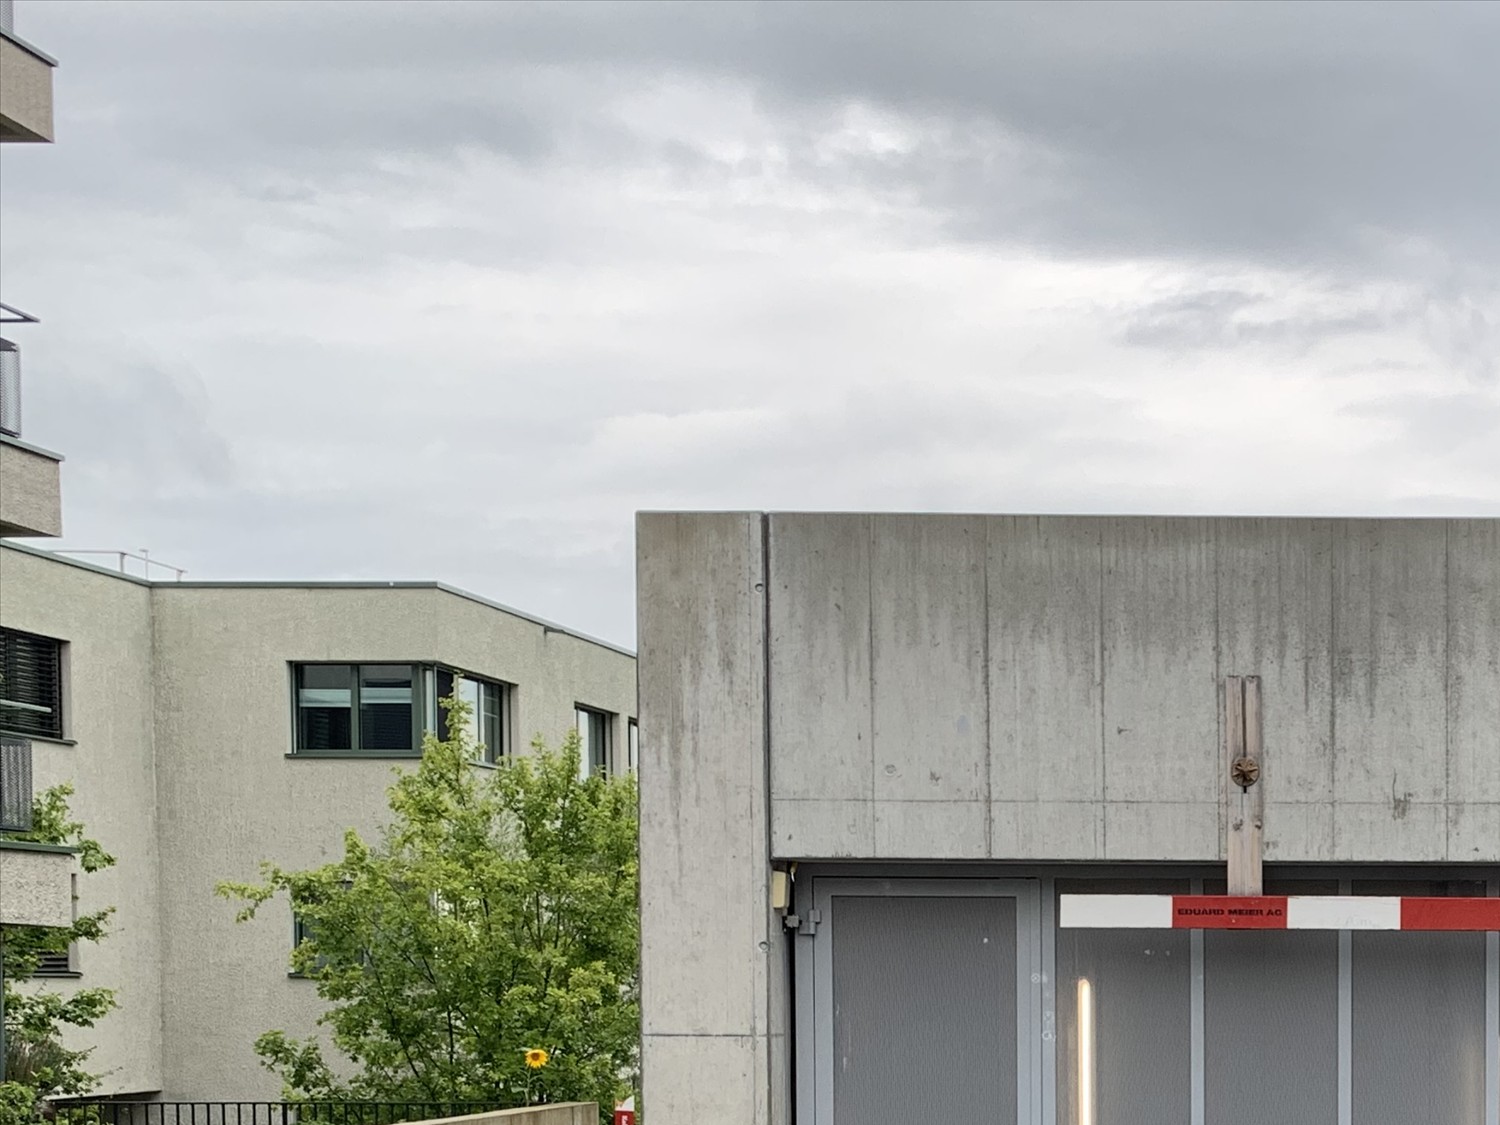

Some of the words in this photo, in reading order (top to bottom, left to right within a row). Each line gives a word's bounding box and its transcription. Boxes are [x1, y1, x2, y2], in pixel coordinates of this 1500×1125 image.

[1177, 907, 1225, 916] EDUARD
[1227, 908, 1264, 917] MEIER
[1266, 908, 1283, 917] AG
